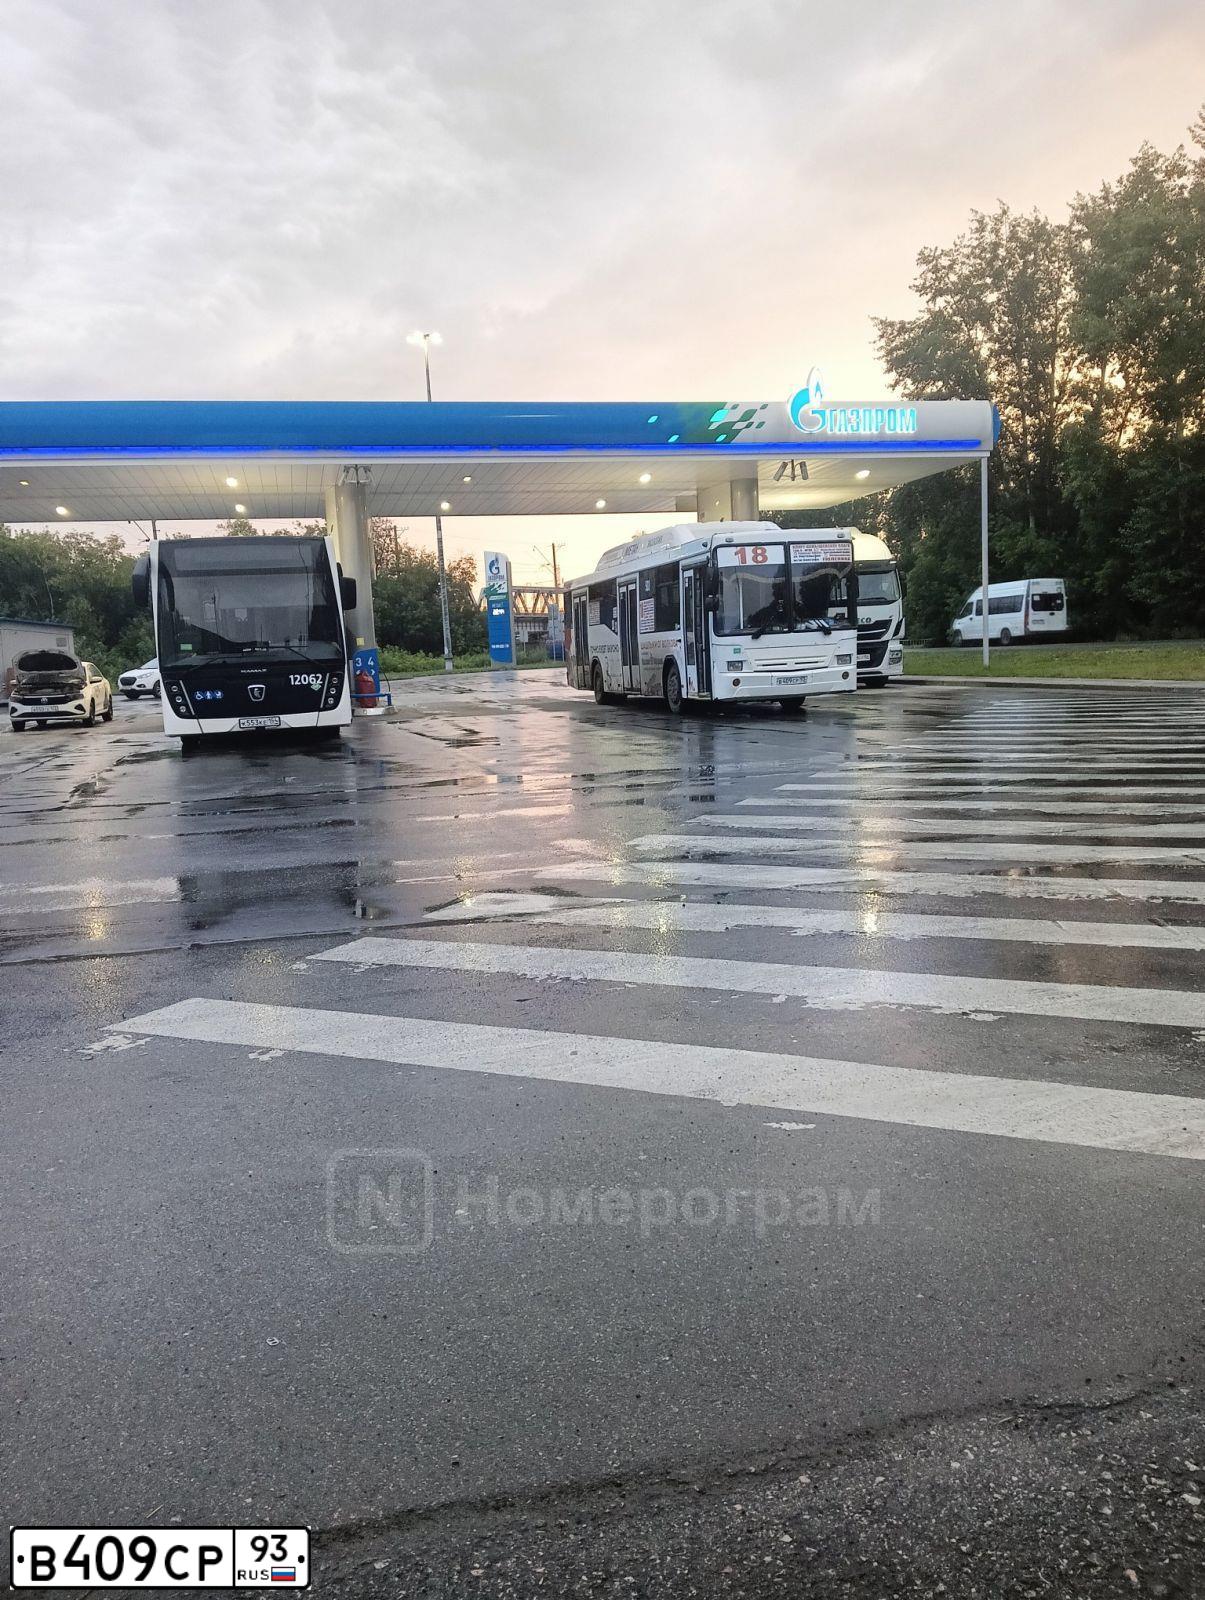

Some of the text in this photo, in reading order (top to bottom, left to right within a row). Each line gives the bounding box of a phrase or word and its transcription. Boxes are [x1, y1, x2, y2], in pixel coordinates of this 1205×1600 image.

[828, 408, 917, 434] ГАЗПРОМ
[734, 545, 768, 564] 18
[355, 656, 374, 666] 3 4
[289, 673, 323, 685] 12062
